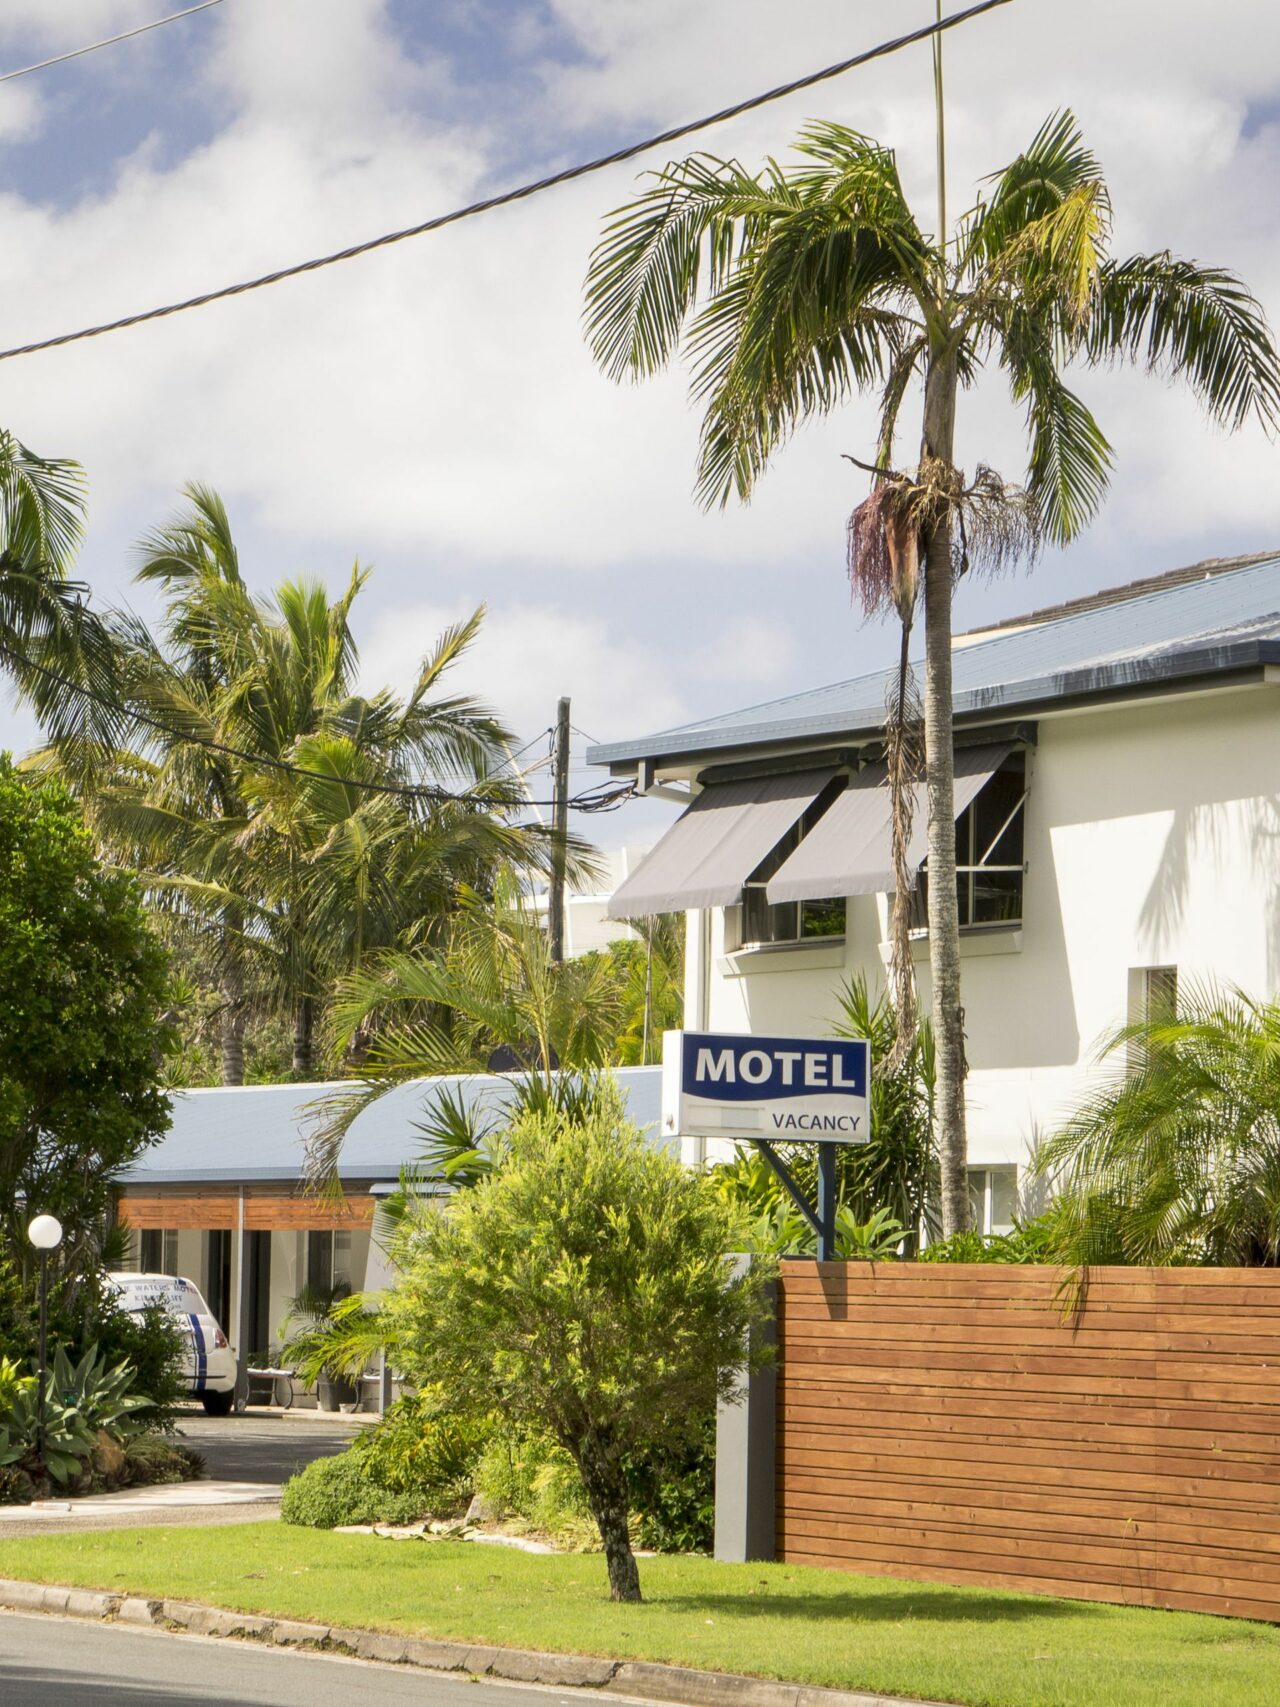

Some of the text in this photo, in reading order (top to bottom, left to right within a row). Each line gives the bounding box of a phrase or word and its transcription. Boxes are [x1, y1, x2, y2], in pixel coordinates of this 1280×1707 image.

[695, 1048, 856, 1088] MOTEL
[772, 1113, 861, 1131] VACANCY
[135, 1284, 170, 1292] WATERS
